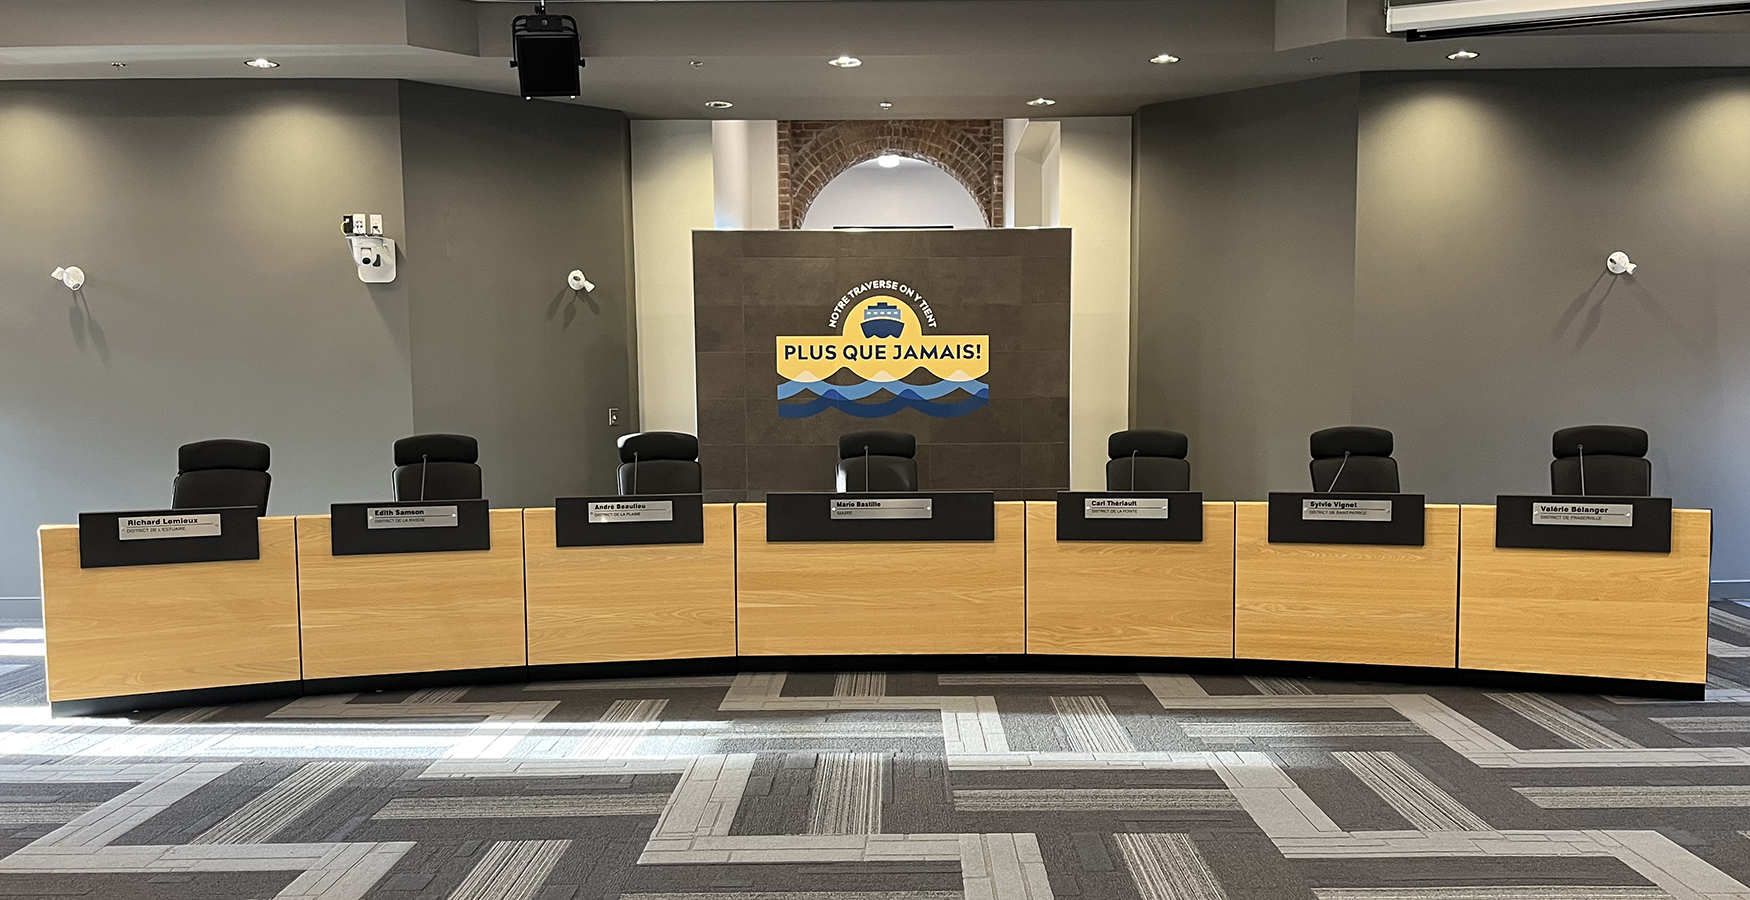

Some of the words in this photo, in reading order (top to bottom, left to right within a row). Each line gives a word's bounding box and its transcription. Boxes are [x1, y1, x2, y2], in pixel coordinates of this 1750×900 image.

[828, 296, 850, 328] NOTRE
[848, 280, 898, 299] TRAVERSE
[899, 284, 915, 298] ON
[913, 293, 922, 302] Y
[919, 300, 938, 328] TIENT
[784, 344, 837, 360] PLUS
[843, 344, 886, 362] QUE
[892, 344, 982, 360] JAMAIS!
